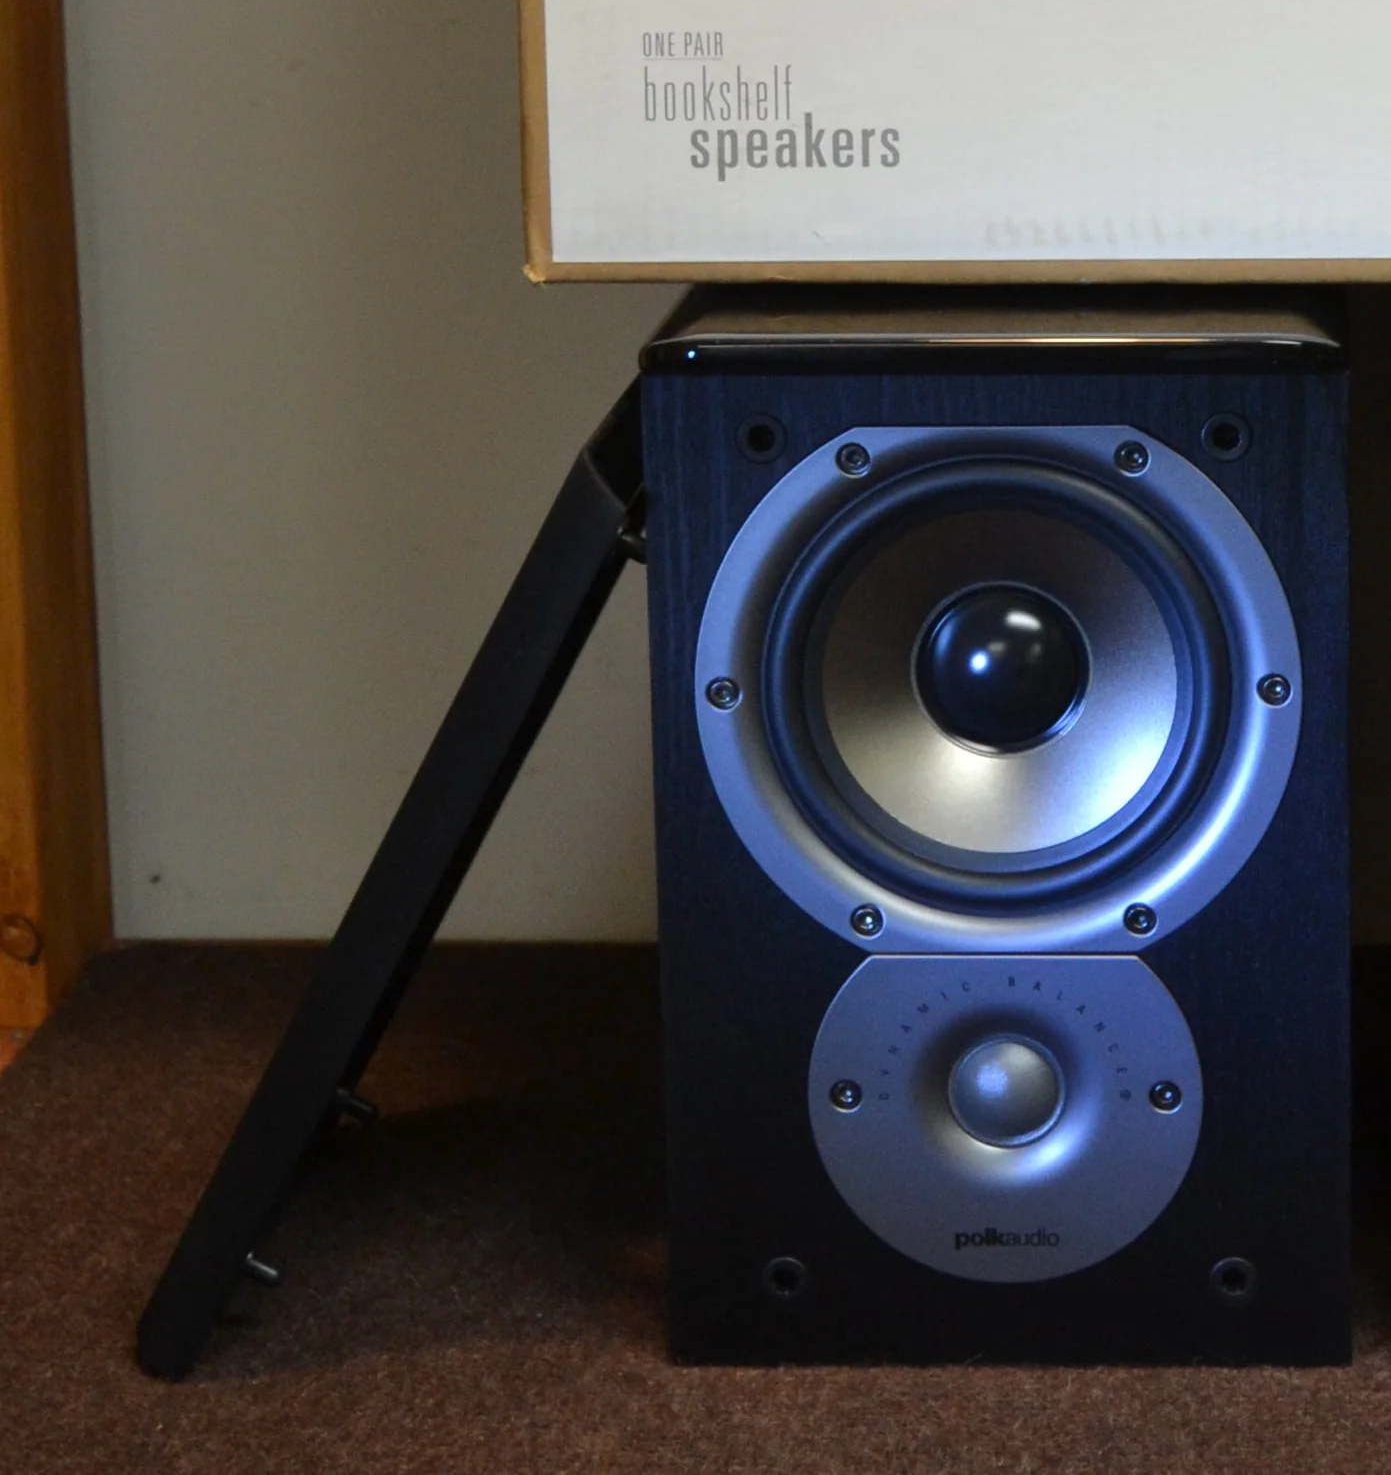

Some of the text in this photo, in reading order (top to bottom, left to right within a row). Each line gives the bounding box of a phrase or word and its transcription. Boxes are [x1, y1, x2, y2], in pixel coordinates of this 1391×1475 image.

[642, 31, 725, 58] ONE PAIR
[643, 64, 793, 122] bookshelf
[689, 111, 901, 183] speakers
[953, 1227, 1060, 1251] polkaudio
